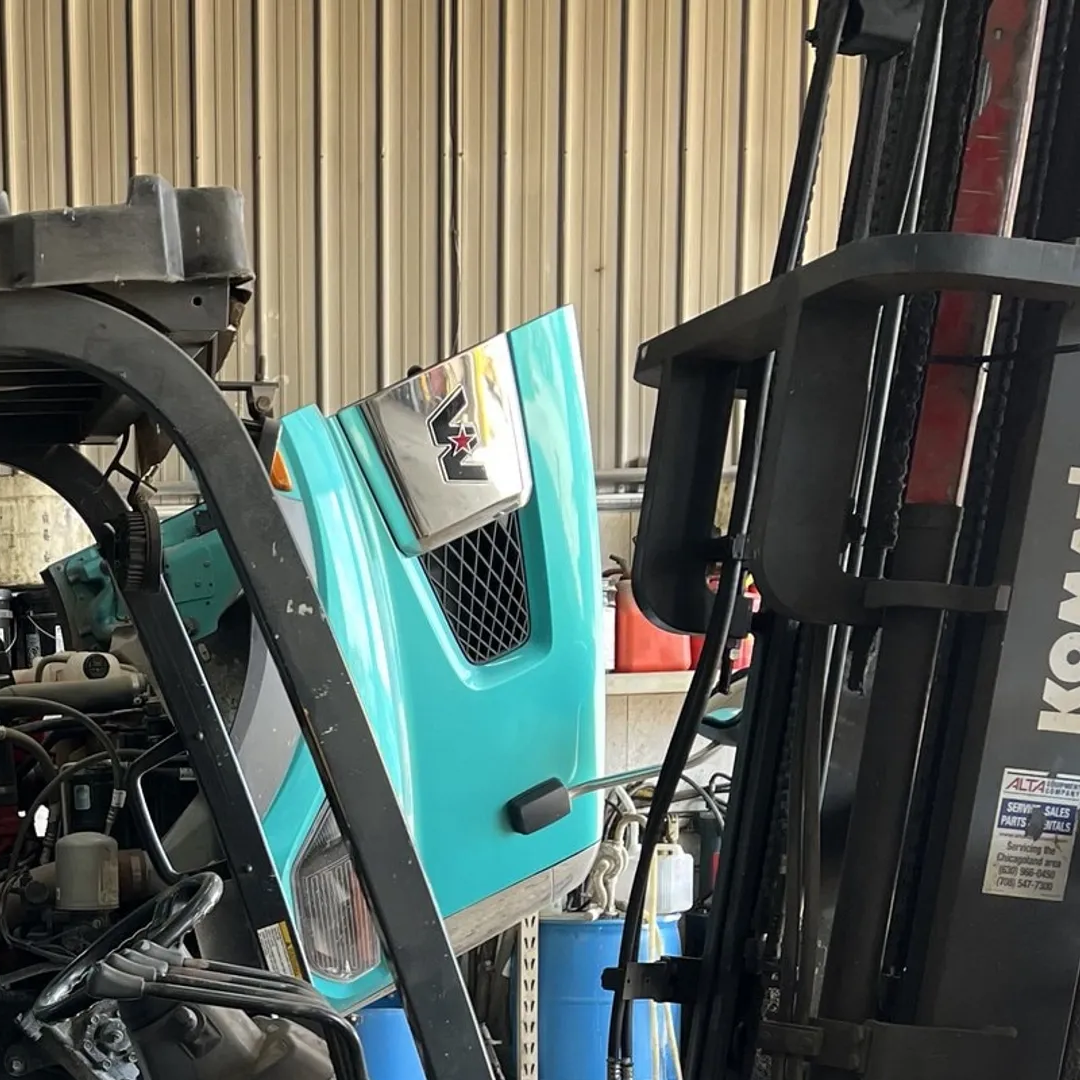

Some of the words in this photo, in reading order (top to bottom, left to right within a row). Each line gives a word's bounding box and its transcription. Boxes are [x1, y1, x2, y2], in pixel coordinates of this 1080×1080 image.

[1006, 777, 1046, 793] ALTA
[1044, 805, 1071, 818] SALES
[1001, 815, 1027, 828] PARTS
